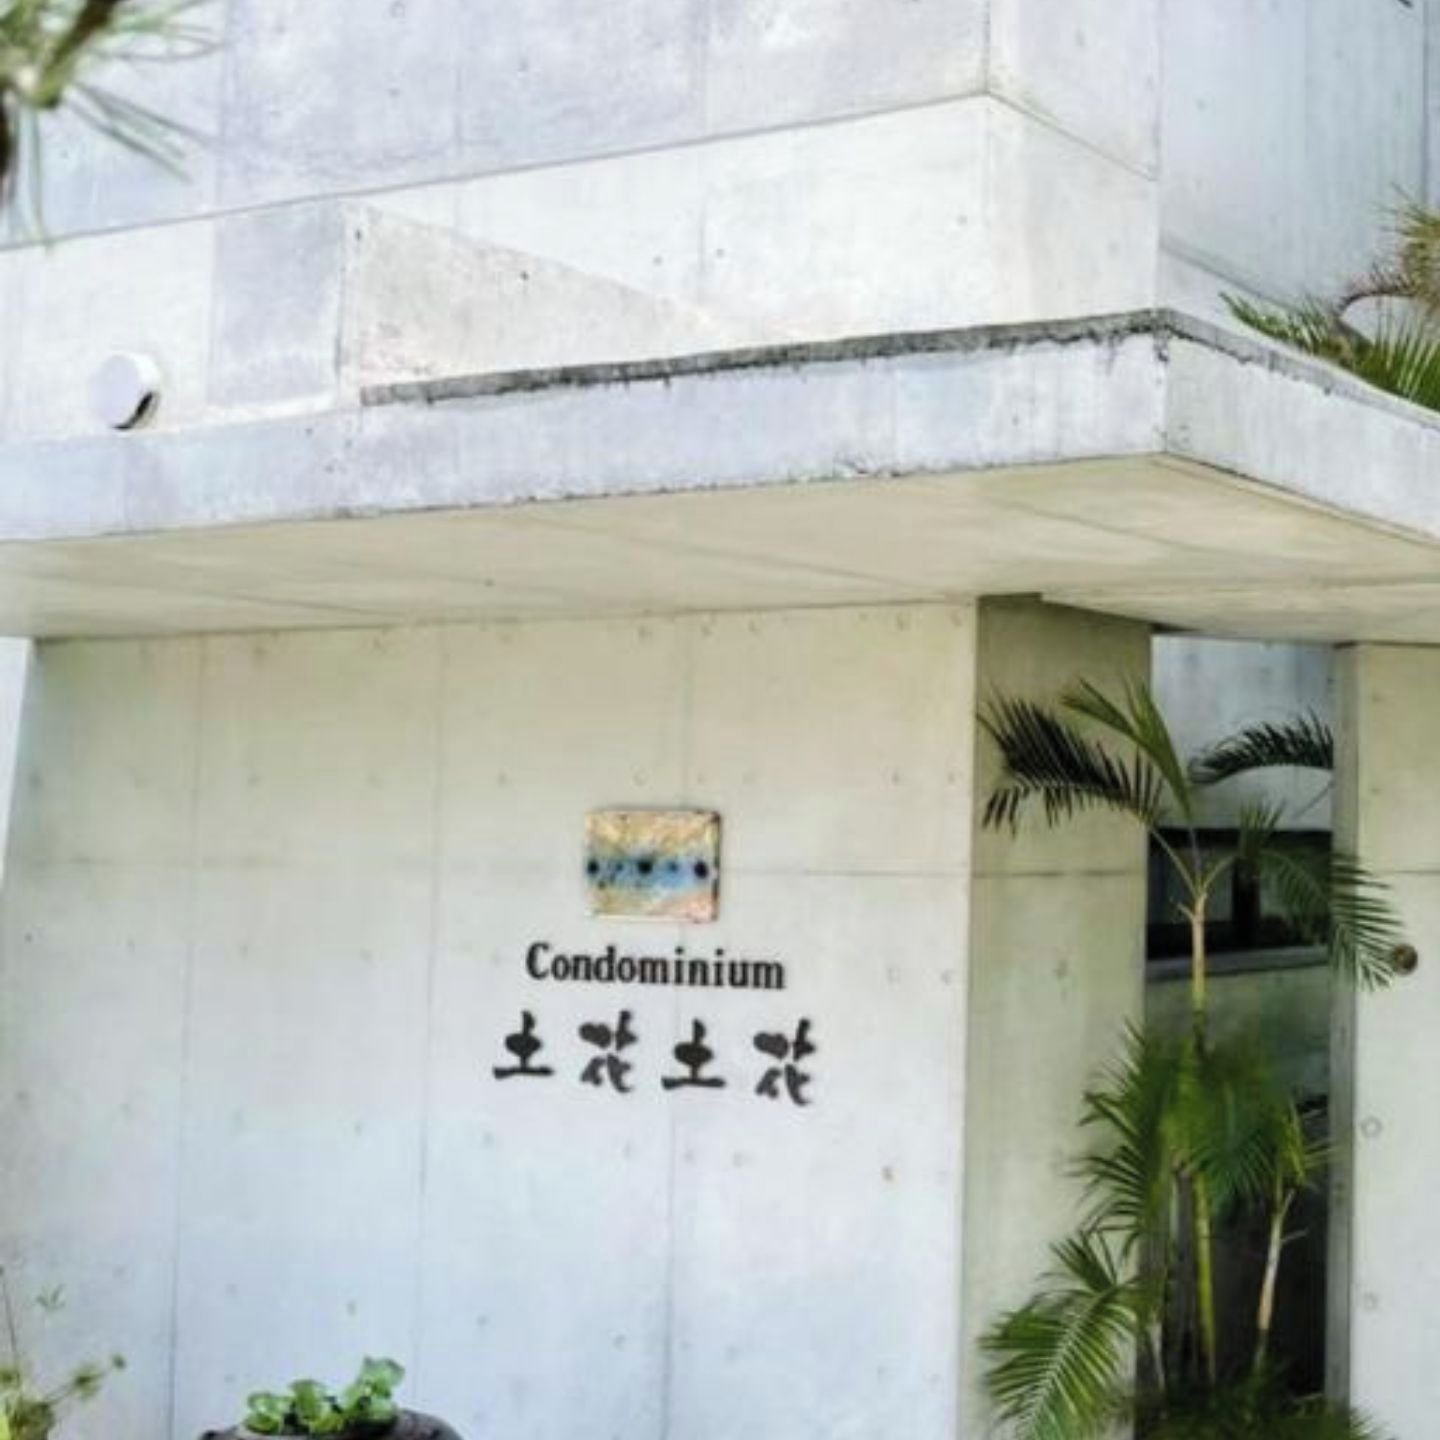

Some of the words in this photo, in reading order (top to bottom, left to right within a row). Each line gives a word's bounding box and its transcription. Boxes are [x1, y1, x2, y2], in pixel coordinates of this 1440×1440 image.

[525, 942, 786, 989] Condominium
[493, 1009, 817, 1106] 土花土花
